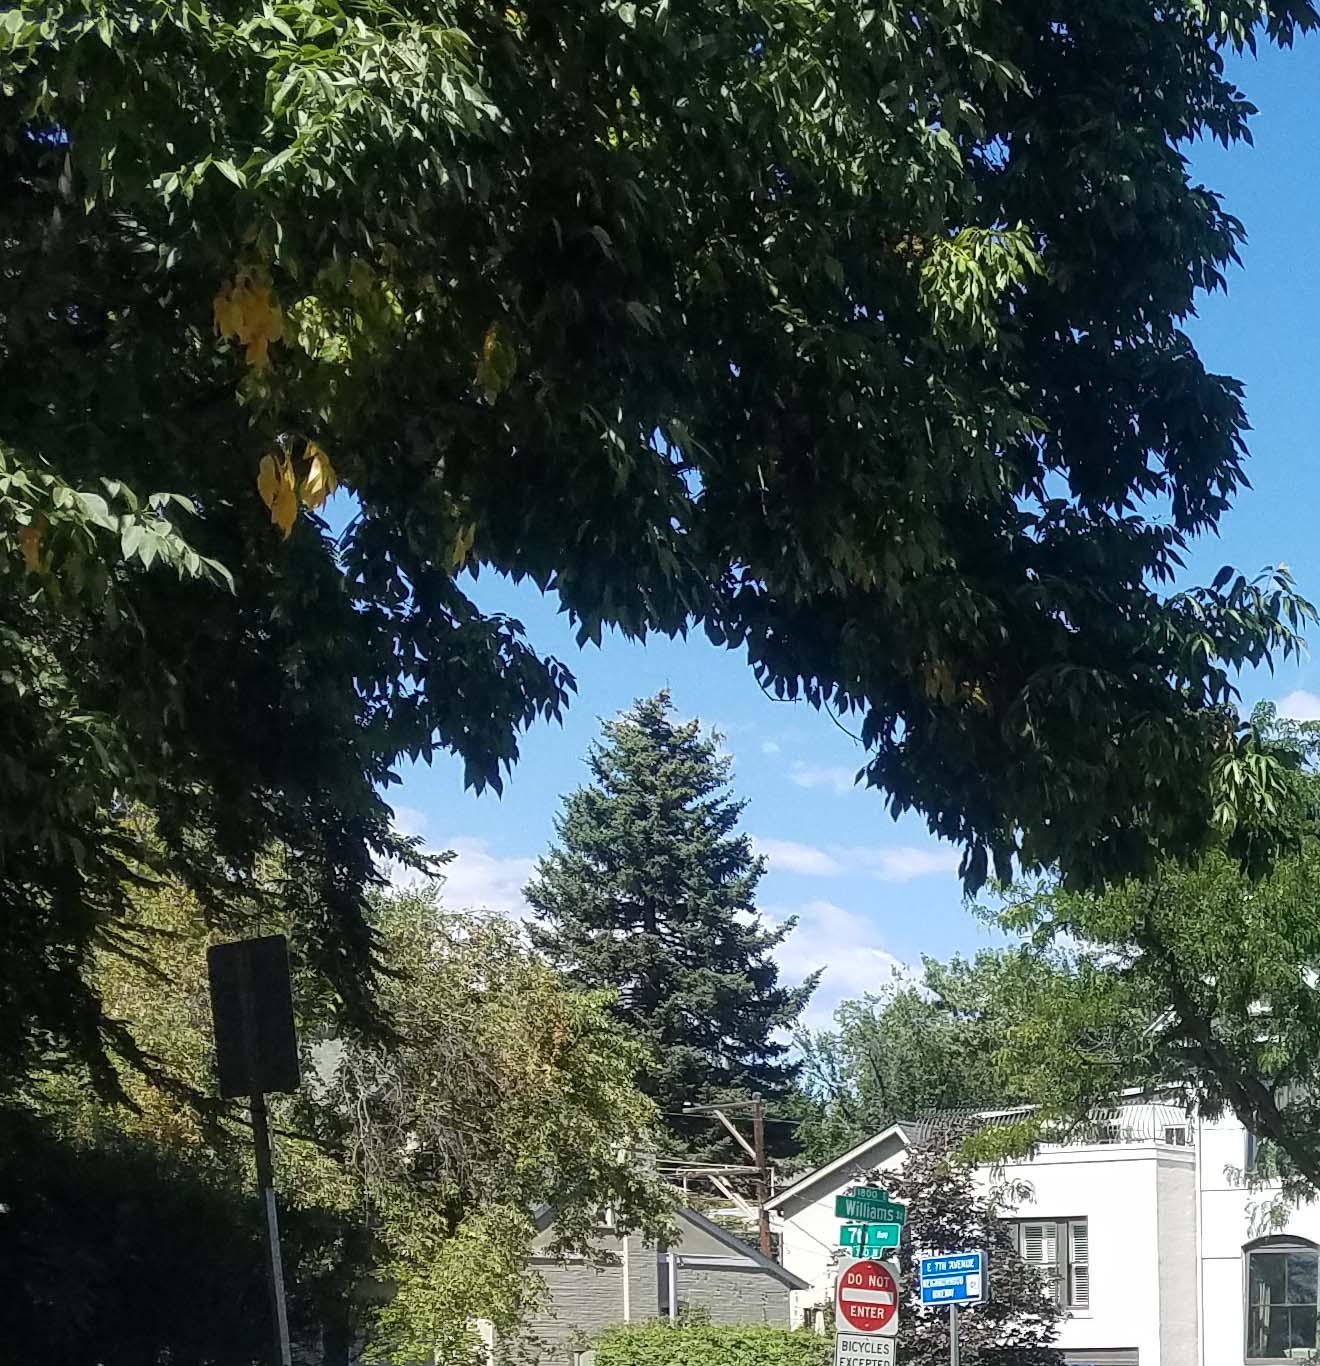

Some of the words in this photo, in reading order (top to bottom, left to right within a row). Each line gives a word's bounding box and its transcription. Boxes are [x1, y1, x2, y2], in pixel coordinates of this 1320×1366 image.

[845, 1199, 894, 1222] Williams
[848, 1273, 863, 1285] DO
[868, 1275, 890, 1288] NOT
[850, 1305, 885, 1319] ENTER
[841, 1341, 890, 1355] BICYCLES
